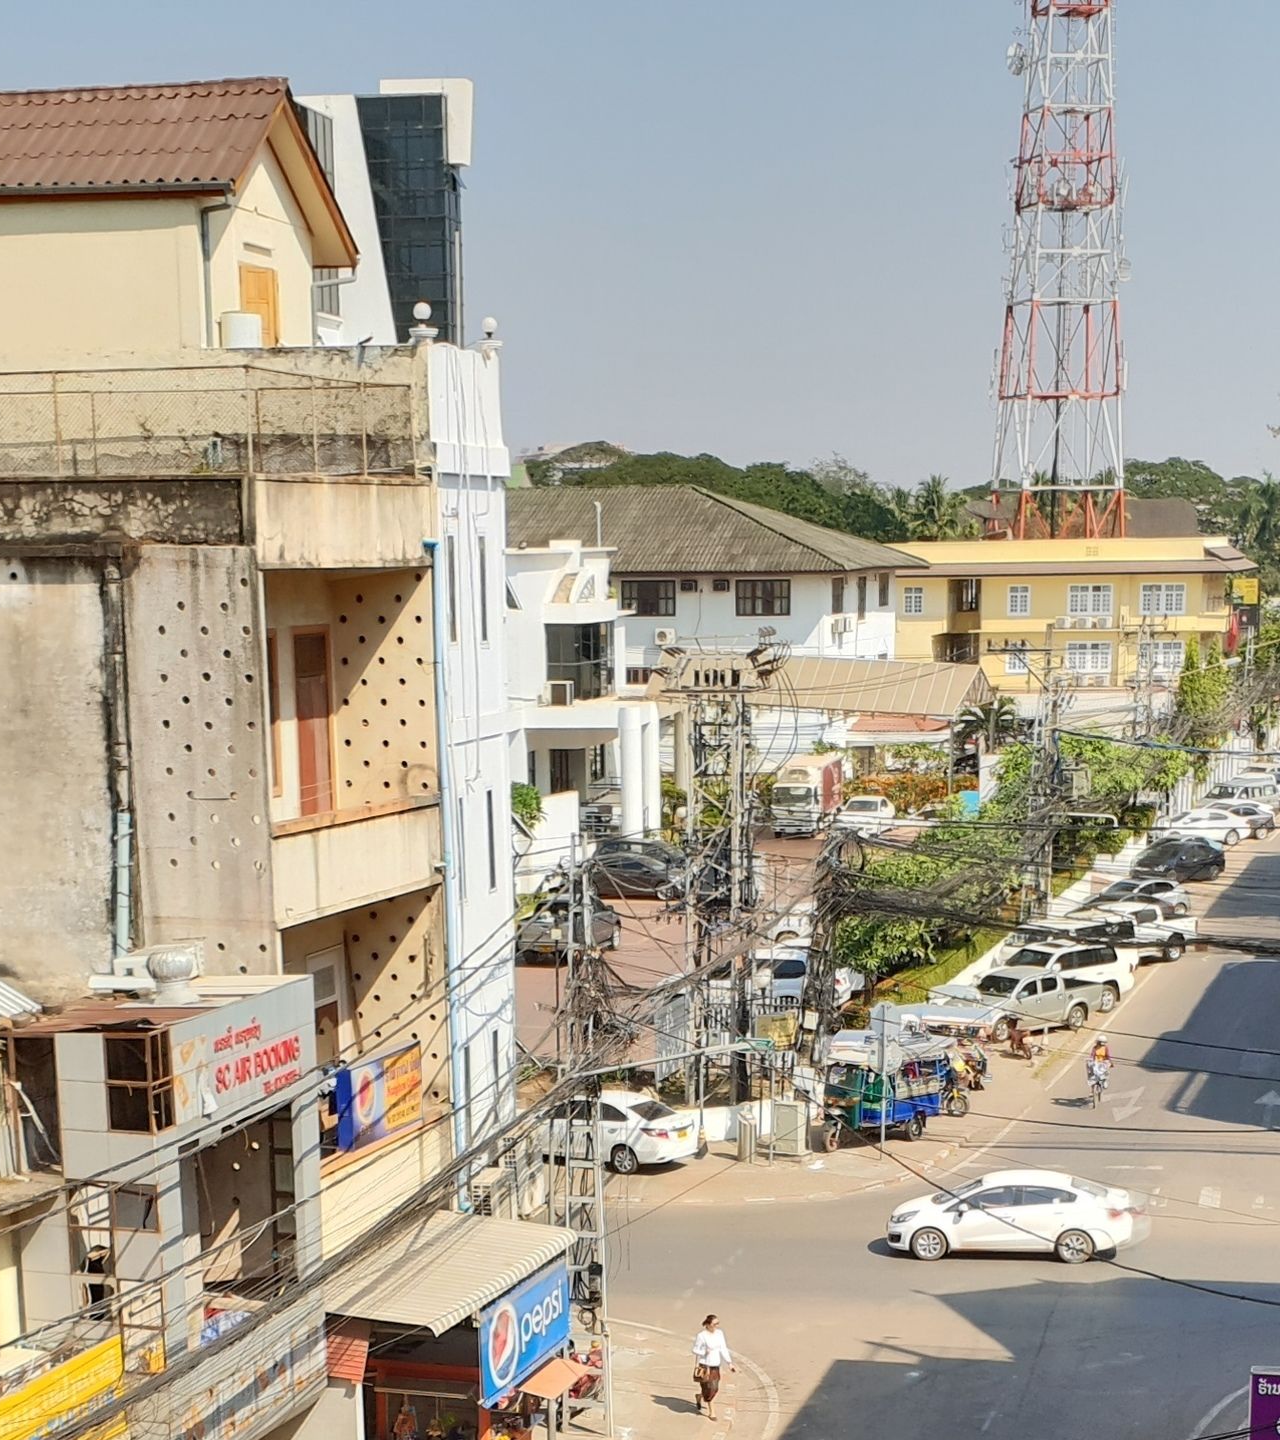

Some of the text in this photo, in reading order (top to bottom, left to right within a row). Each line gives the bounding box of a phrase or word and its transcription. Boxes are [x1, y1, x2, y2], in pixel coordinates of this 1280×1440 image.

[233, 1056, 252, 1087] AIR
[254, 1036, 300, 1079] BOOKING
[521, 1280, 563, 1353] pepsi
